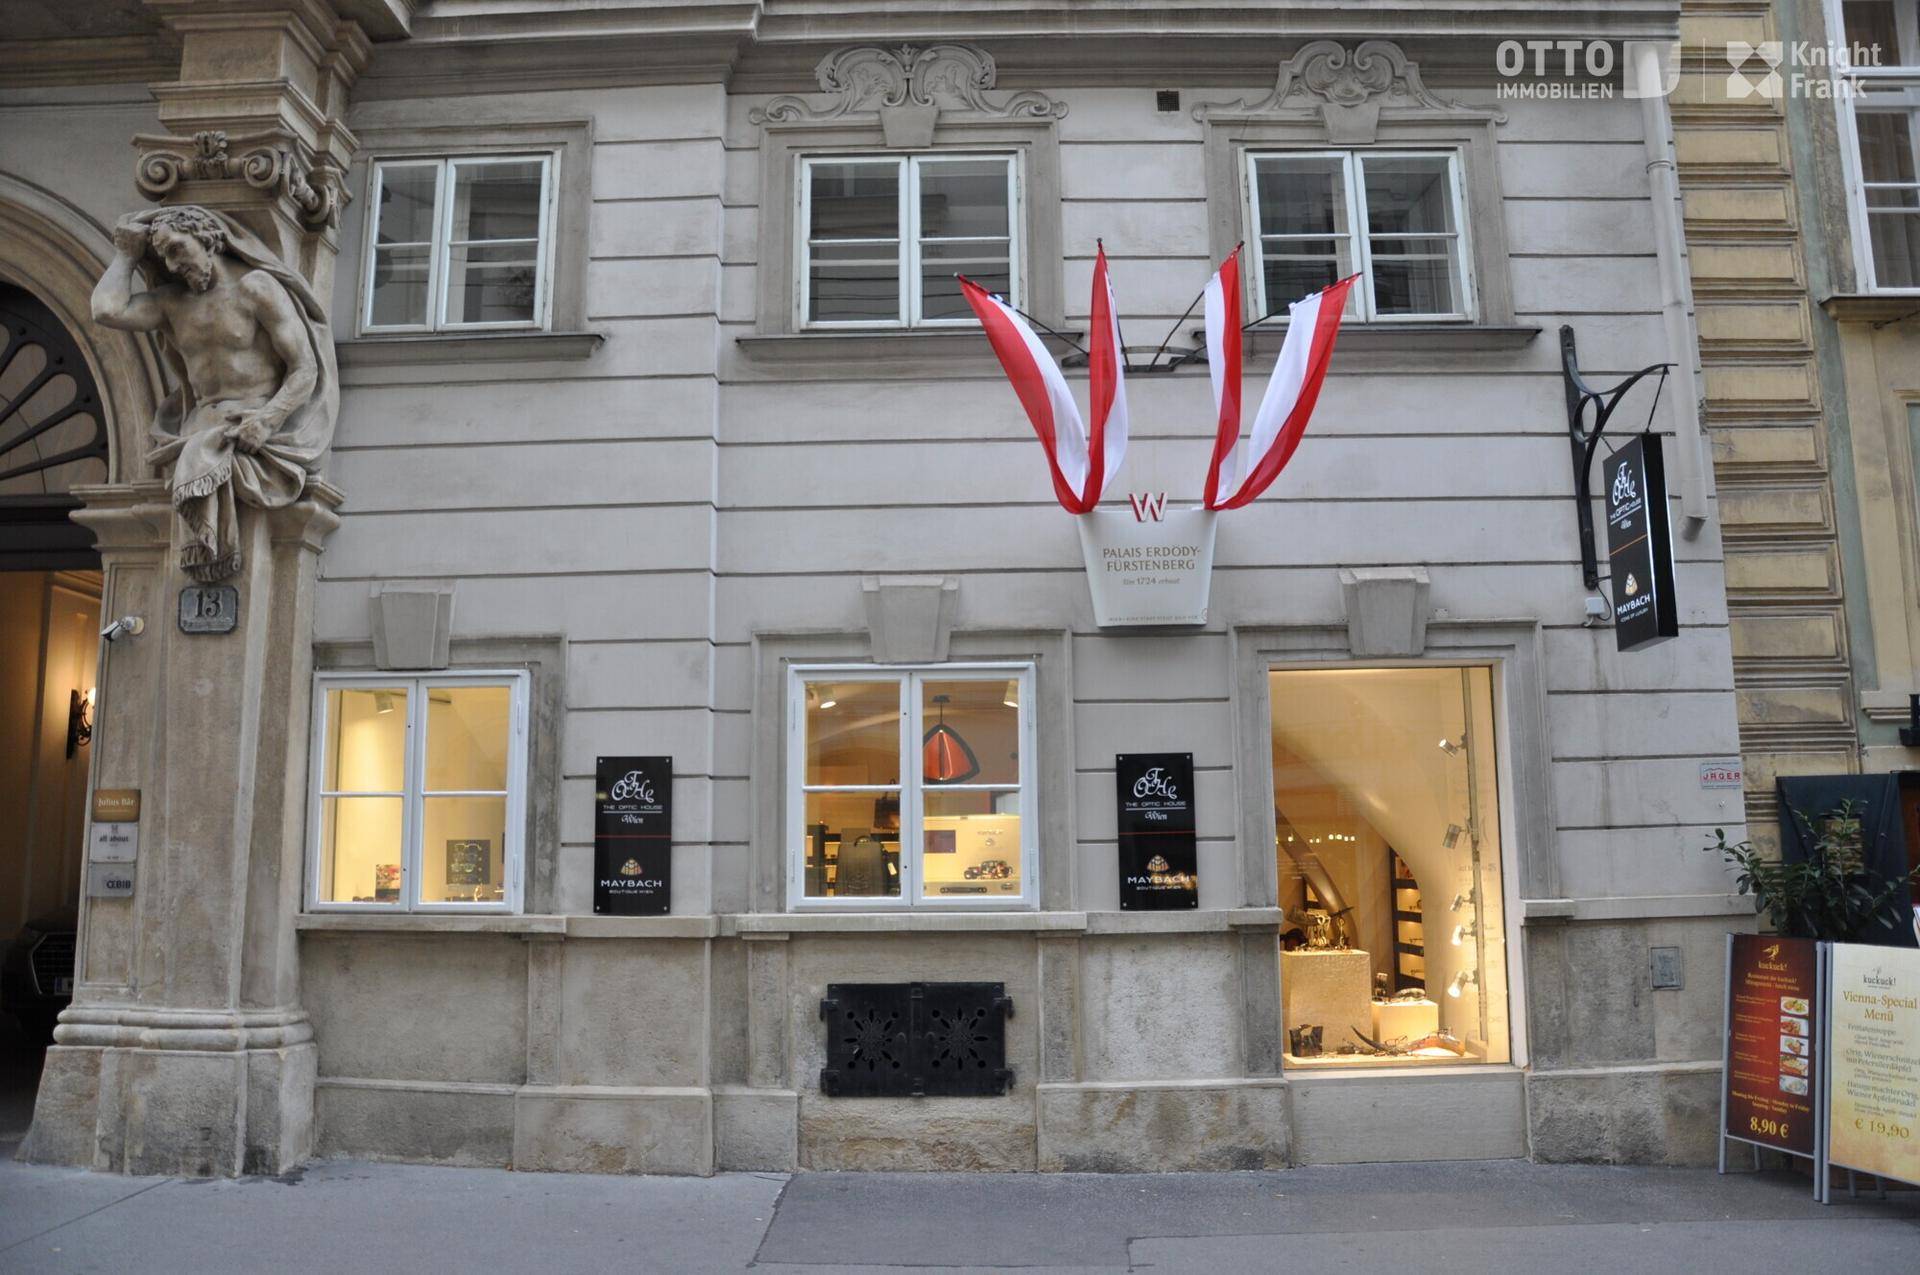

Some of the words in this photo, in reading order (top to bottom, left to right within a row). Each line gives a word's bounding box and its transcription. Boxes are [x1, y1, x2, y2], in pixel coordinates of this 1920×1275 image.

[1128, 491, 1169, 523] W
[1103, 547, 1142, 559] PALAIS
[1106, 559, 1195, 572] FÜRSTENBERG
[1137, 576, 1157, 585] 1724
[1617, 593, 1650, 615] MAYBACH
[98, 797, 119, 807] Julius
[601, 880, 663, 888] MAYBACH
[1127, 875, 1190, 884] MAYBACH
[1863, 975, 1896, 986] kuckuck!
[1843, 990, 1917, 1010] Vienna-Special
[1864, 1008, 1894, 1022] Menü
[1750, 1116, 1777, 1135] 8,90
[1780, 1123, 1789, 1138] €
[1855, 1117, 1863, 1130] €
[1869, 1120, 1909, 1139] 19,90
